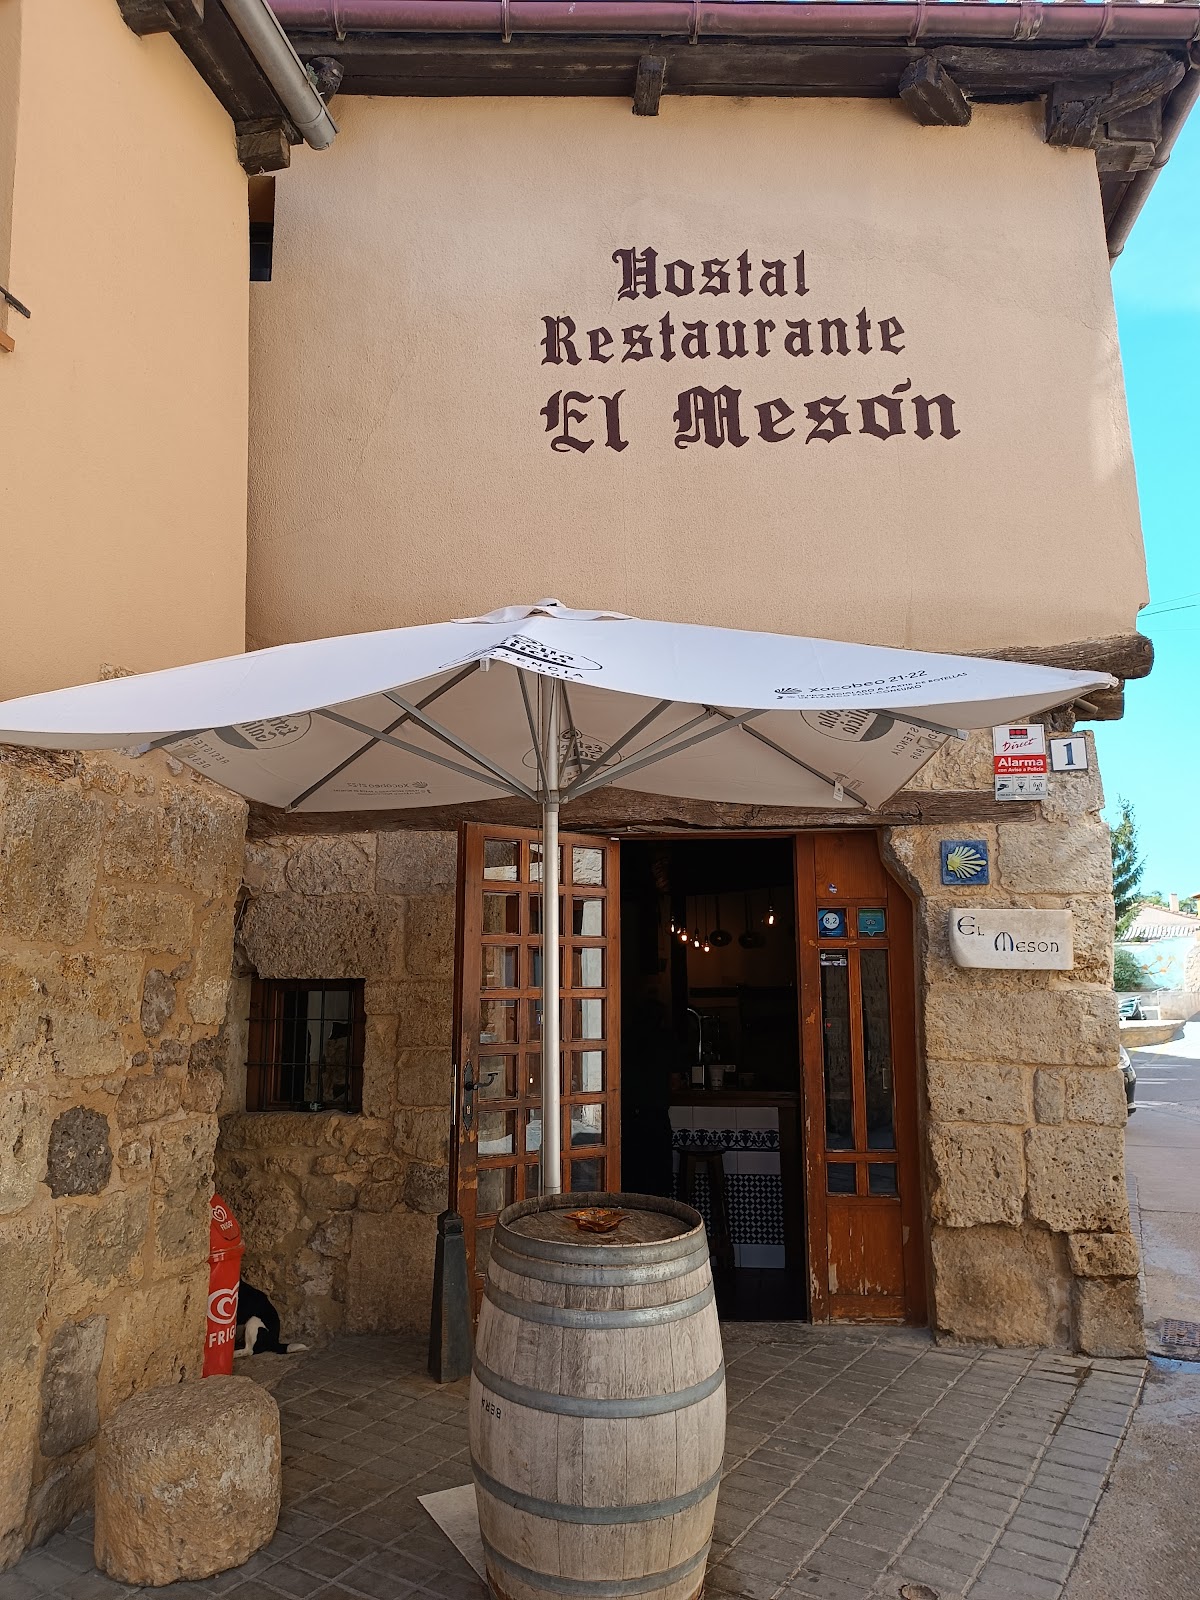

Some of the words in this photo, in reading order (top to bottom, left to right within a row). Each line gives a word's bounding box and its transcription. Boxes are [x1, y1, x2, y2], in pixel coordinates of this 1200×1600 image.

[612, 246, 810, 301] Hostal
[541, 306, 906, 366] Restaurante
[540, 389, 629, 454] El
[673, 377, 961, 450] Mesón
[997, 757, 1044, 767] Alarma
[1063, 742, 1076, 766] 1
[208, 1324, 236, 1349] FRIG
